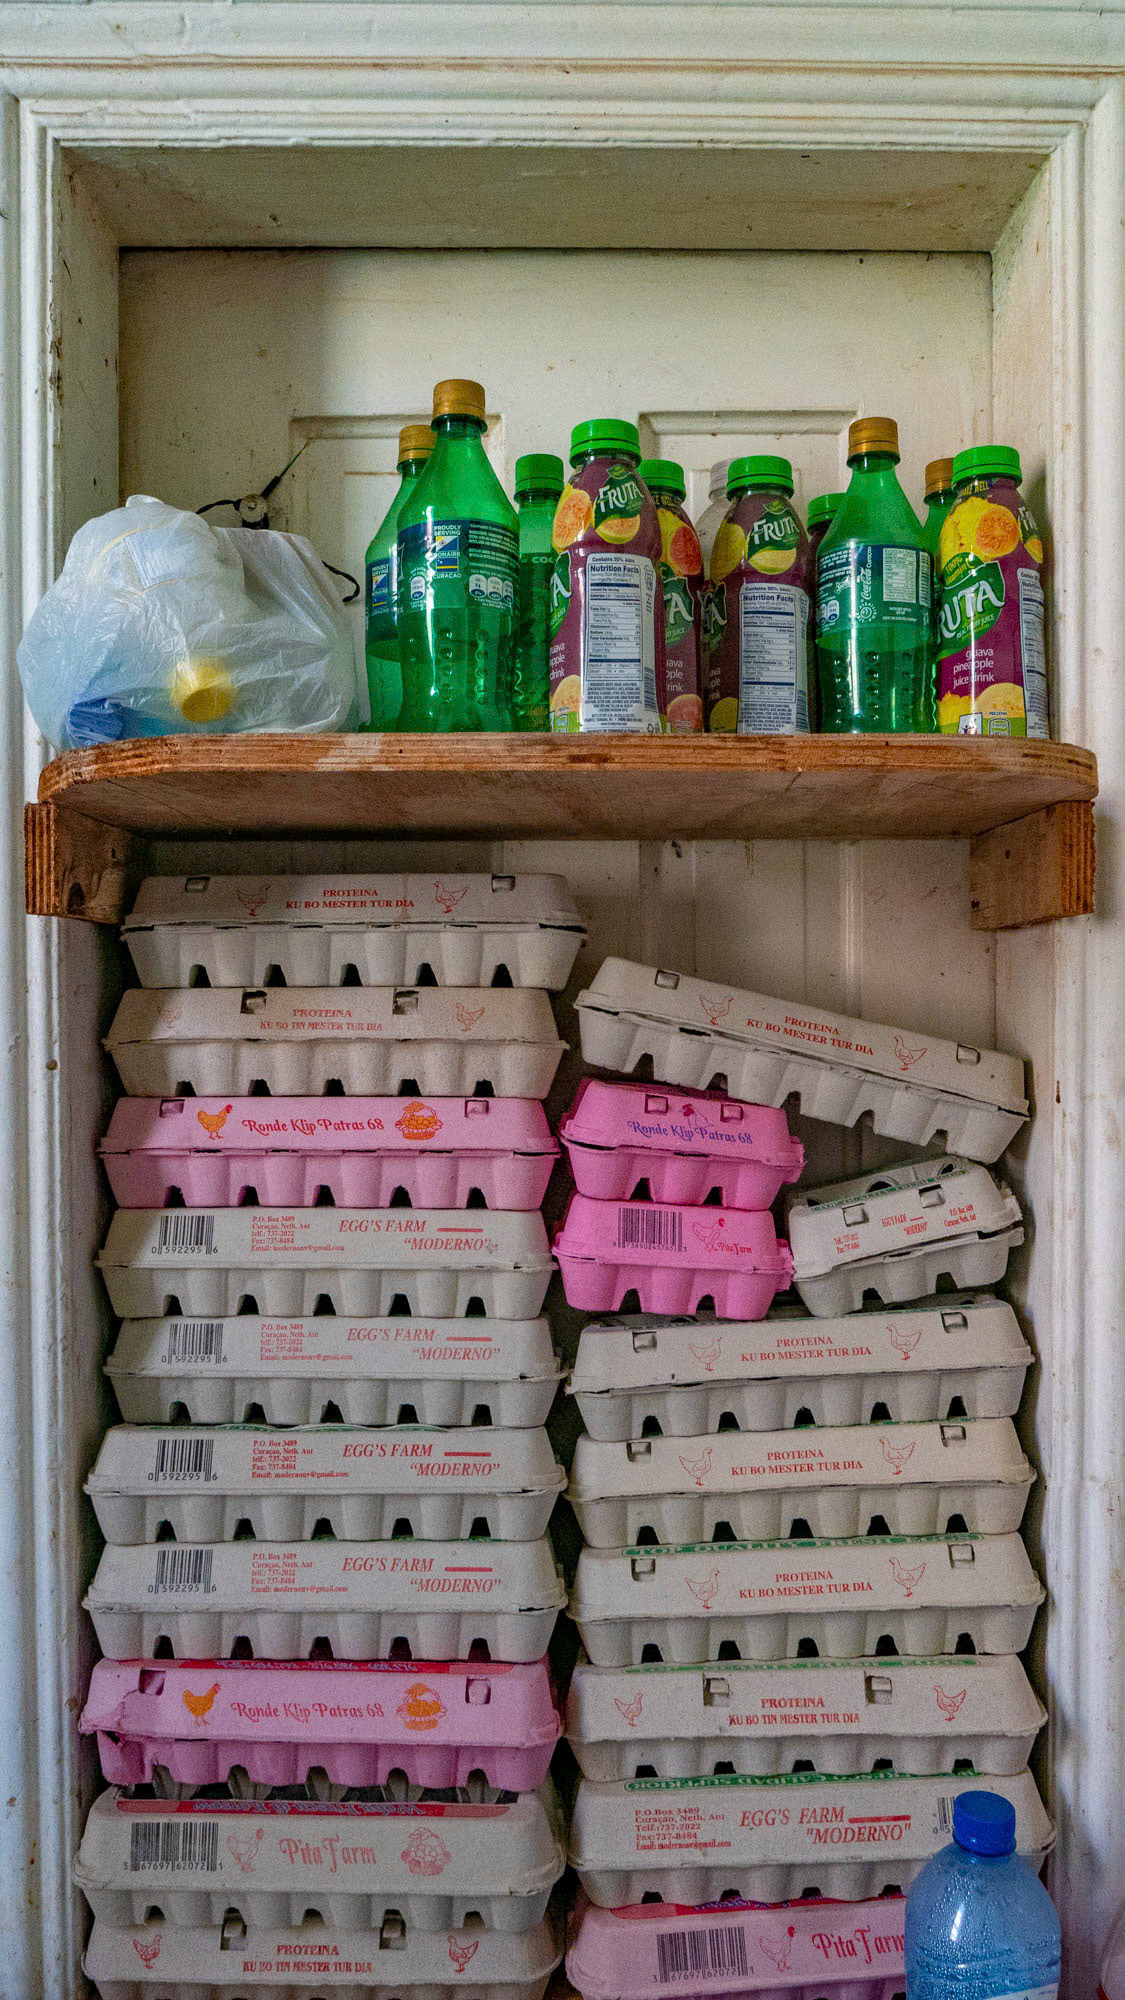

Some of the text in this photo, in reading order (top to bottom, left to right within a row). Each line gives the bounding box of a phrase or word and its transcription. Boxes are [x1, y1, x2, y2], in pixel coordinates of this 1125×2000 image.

[598, 480, 645, 512] FRUTA
[752, 516, 800, 544] FRUTA
[939, 581, 1005, 639] RUTA
[966, 648, 994, 660] guava
[953, 658, 994, 675] pineapple
[953, 676, 969, 690] juice
[323, 889, 379, 897] PROTEINA
[286, 899, 415, 909] KU BO MESTER TUR DIA
[292, 1009, 353, 1018] PROTEINA
[260, 1022, 384, 1032] KU BO TIN MESTER TUR DIA
[784, 1015, 840, 1035] PROTEINA
[747, 1018, 875, 1056] KU BO MESTER TUR DIA
[242, 1118, 385, 1136] Ronde Klip Patras 68
[627, 1120, 753, 1144] Ronde Klip Patras 68
[339, 1219, 427, 1233] EGG'S FARM
[212, 1246, 218, 1254] 6
[404, 1237, 491, 1251] “MODERNO”
[347, 1328, 435, 1341] EGG'S FARM
[776, 1336, 833, 1347] PROTEINA
[161, 1355, 228, 1363] 0 592295 6
[412, 1347, 501, 1361] “MODERNO”
[741, 1346, 872, 1362] KU BO MESTER TUR DIA
[342, 1444, 433, 1457] EGG'S FARM
[767, 1449, 824, 1460] PROTEINA
[410, 1462, 500, 1476] “MODERNO”
[731, 1460, 863, 1476] KU BO MESTER TUR DIA
[147, 1472, 218, 1480] 0 592295 6
[342, 1557, 435, 1572] EGG'S FARM
[775, 1570, 834, 1582] PROTEINA
[147, 1584, 217, 1593] 0 592295 6
[410, 1577, 501, 1593] “MODERNO”
[739, 1581, 873, 1599] KU BO MESTER TUR DIA
[761, 1697, 825, 1708] PROTEINA
[230, 1702, 384, 1723] Ronde Klip Patras 68
[728, 1713, 860, 1726] KU BO TIN MESTER TUR DIA
[633, 1777, 731, 1790] SUPERIOR
[738, 1774, 827, 1786] CALIDAD
[676, 1807, 700, 1815] 3489
[739, 1806, 846, 1827] EGG'S FARM
[806, 1822, 912, 1845] "MODERNO"
[932, 1827, 939, 1835] 0
[279, 1834, 377, 1873] Pita Farm
[141, 1861, 206, 1870] 67697 62072
[276, 1945, 339, 1955] PROTEINA
[811, 1932, 857, 1959] Pita
[243, 1962, 256, 1972] KU
[293, 1961, 330, 1972] MESTER
[333, 1962, 352, 1972] TUR
[354, 1962, 372, 1972] DIA
[652, 1974, 658, 1983] 3
[671, 1971, 701, 1982] 67697
[706, 1967, 737, 1979] 62072
